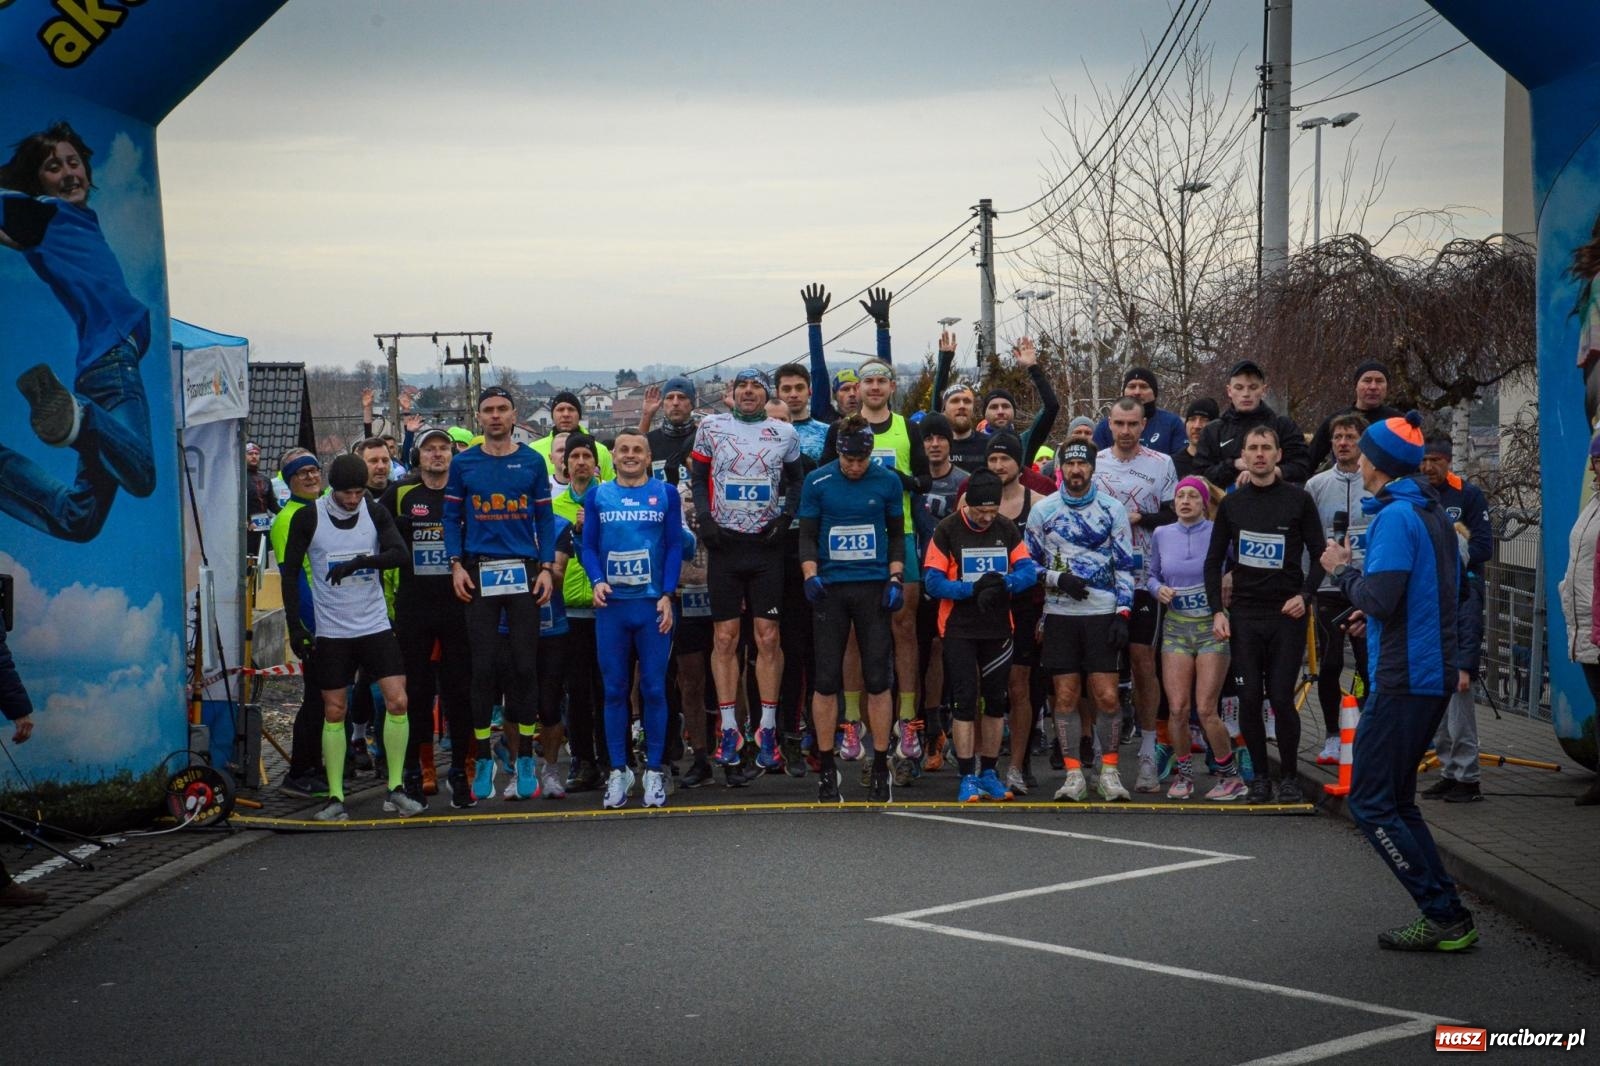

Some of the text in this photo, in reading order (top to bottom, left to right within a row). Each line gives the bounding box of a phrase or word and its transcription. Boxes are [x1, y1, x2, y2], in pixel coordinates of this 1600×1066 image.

[948, 455, 963, 463] UN
[660, 465, 688, 481] 18
[738, 486, 758, 500] 16
[599, 510, 665, 523] RUNNERS
[413, 530, 441, 541] ens
[837, 535, 868, 550] 218
[1245, 541, 1277, 558] 220
[614, 560, 643, 576] 114
[976, 557, 996, 572] 31
[493, 570, 516, 585] 74
[1179, 593, 1208, 609] 153
